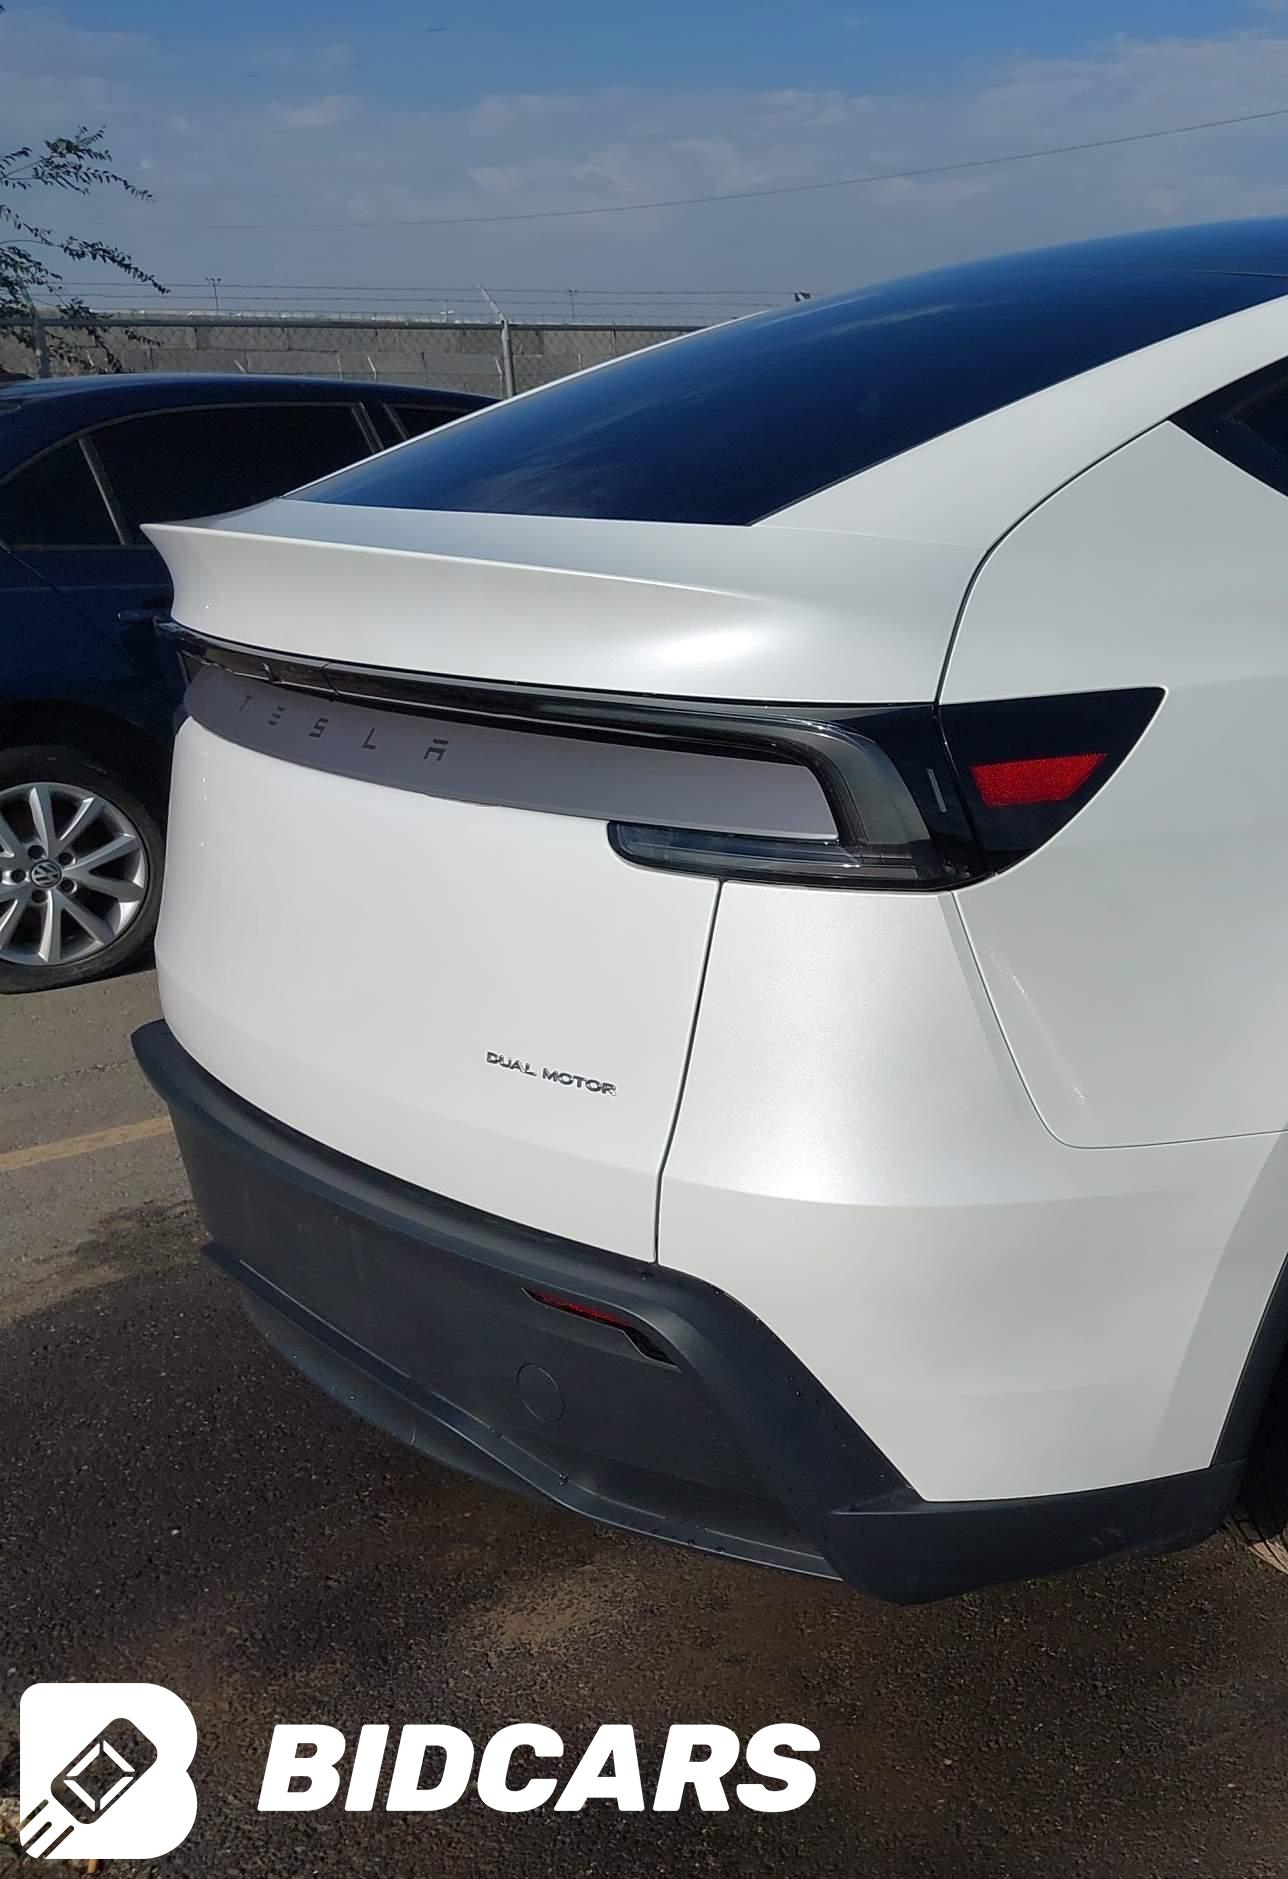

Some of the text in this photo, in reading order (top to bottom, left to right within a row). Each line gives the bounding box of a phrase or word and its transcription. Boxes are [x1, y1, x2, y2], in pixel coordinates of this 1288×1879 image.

[240, 695, 449, 761] TESLA
[486, 1052, 617, 1096] DUAL MOTOR
